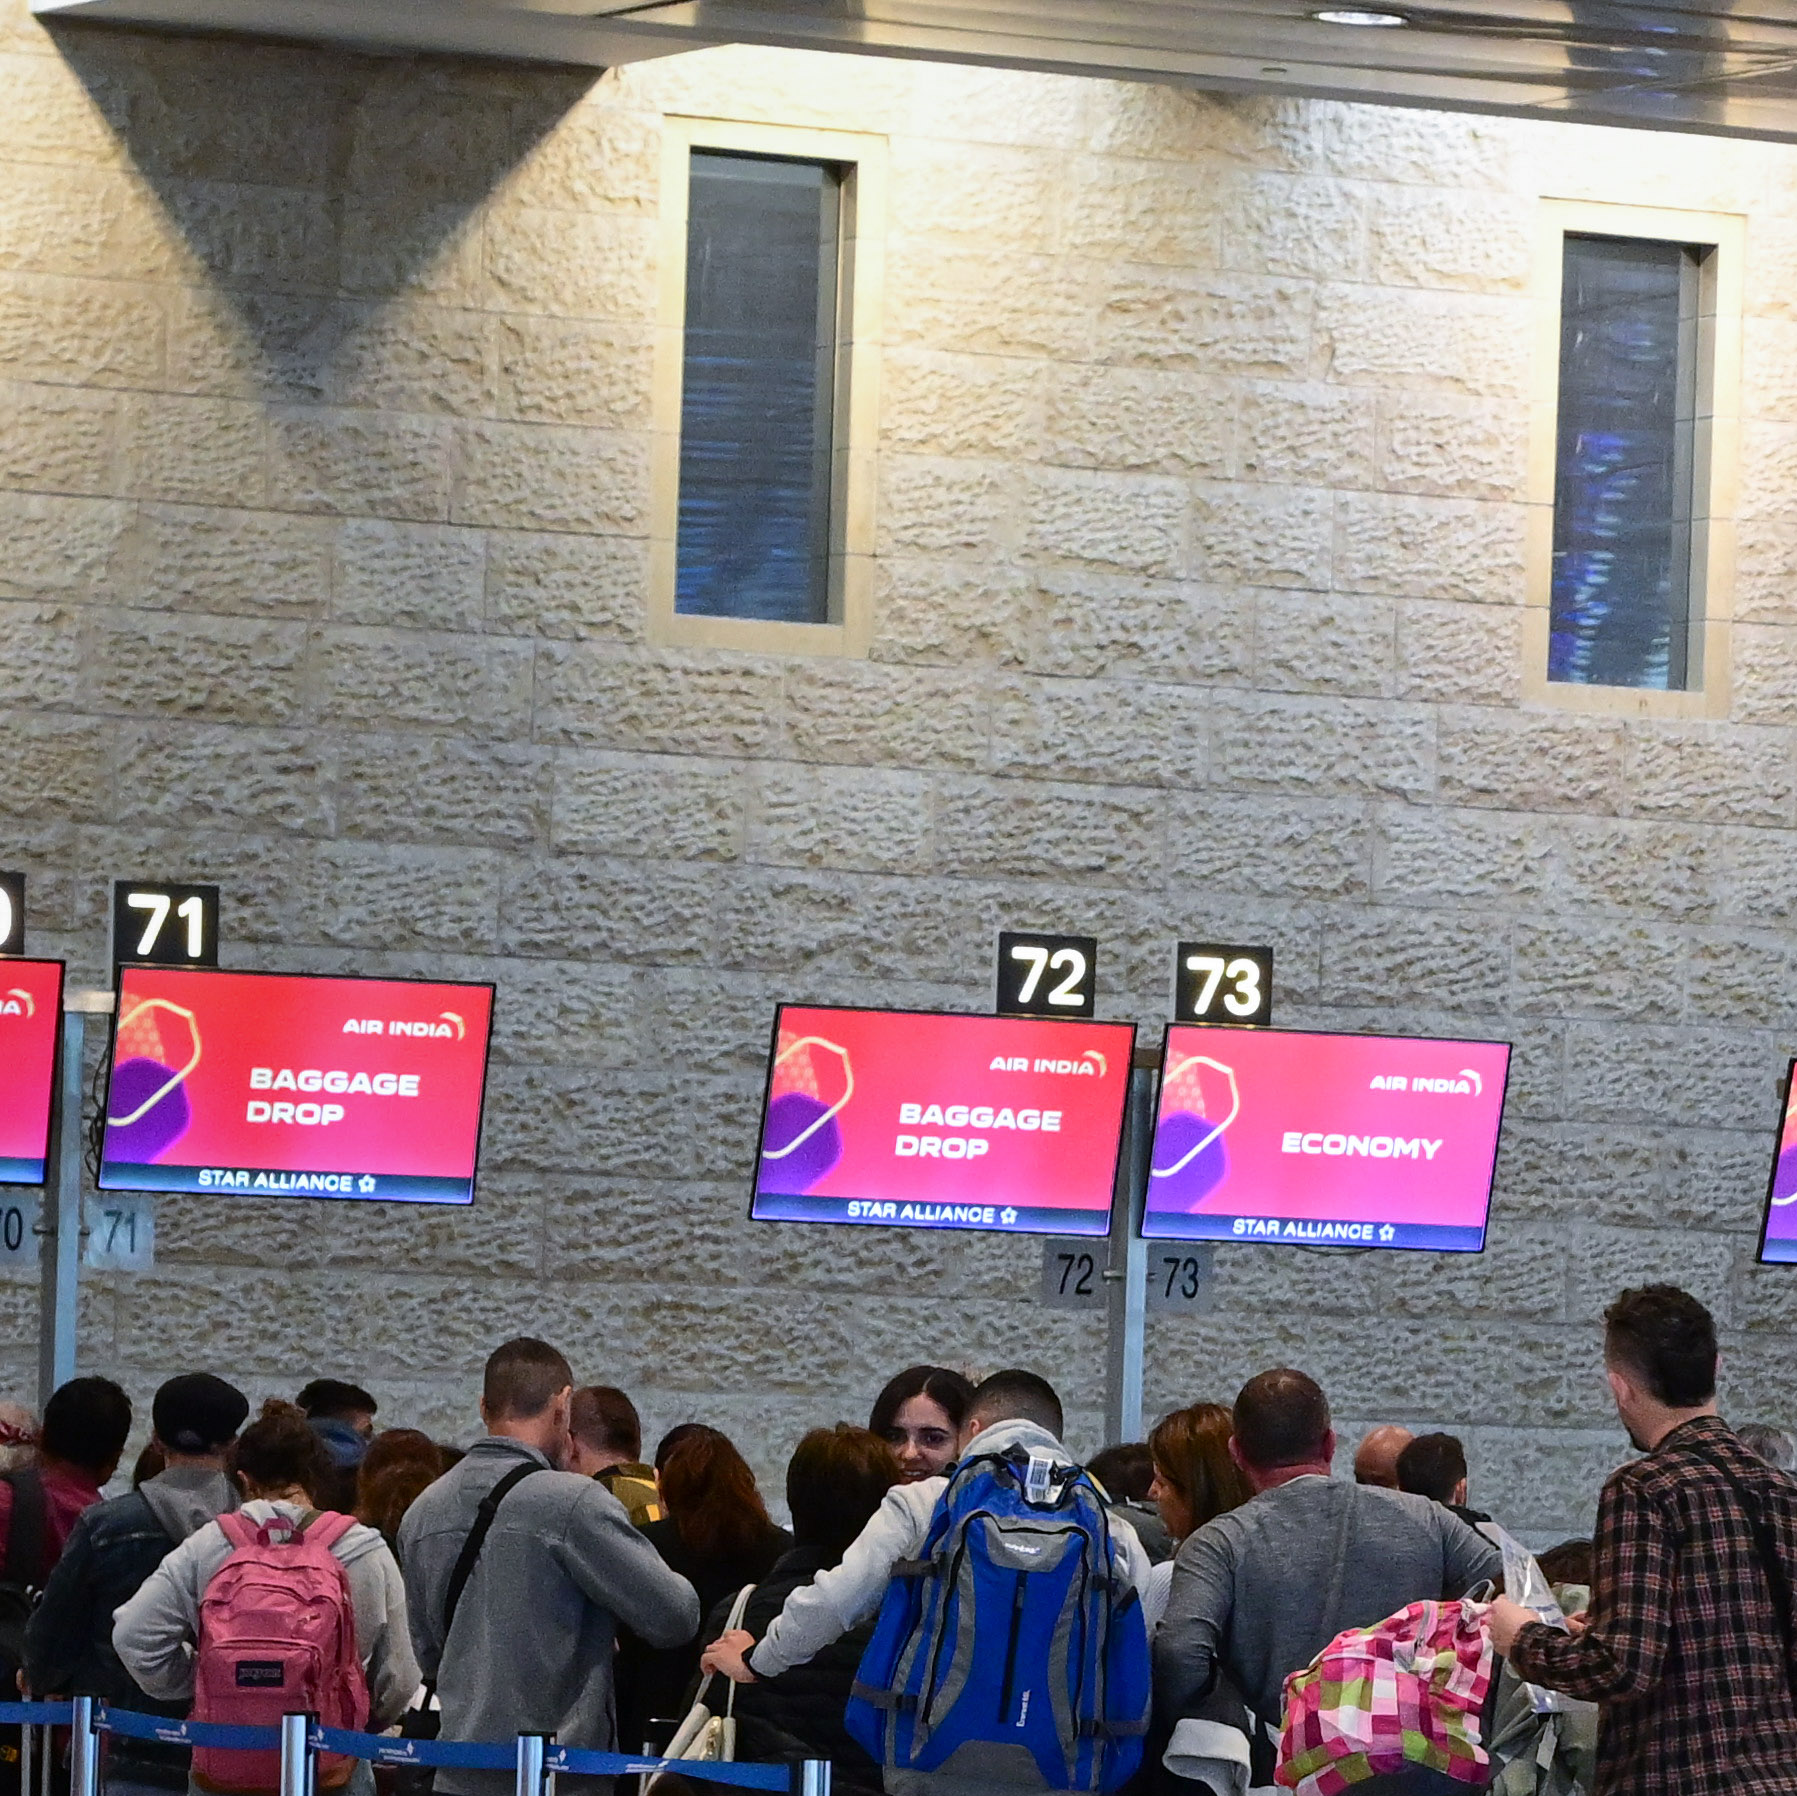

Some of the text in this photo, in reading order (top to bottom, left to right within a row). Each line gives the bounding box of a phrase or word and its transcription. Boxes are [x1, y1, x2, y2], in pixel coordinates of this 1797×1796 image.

[127, 893, 204, 957] 71
[1011, 945, 1087, 1006] 72
[1186, 956, 1261, 1016] 73
[342, 1018, 453, 1038] AIR INDIA
[989, 1056, 1095, 1075] AIR INDIA
[249, 1066, 421, 1097] BAGGAGE
[1369, 1075, 1471, 1094] AIR INDIA
[246, 1100, 345, 1125] DROP
[899, 1103, 1063, 1131] BAGGAGE
[895, 1134, 989, 1159] DROP
[1281, 1131, 1444, 1160] ECONOMY
[197, 1170, 353, 1192] STAR ALLIANCE
[847, 1200, 994, 1224] STAR ALLIANCE
[103, 1209, 136, 1253] 71
[1232, 1218, 1374, 1240] STAR ALLIANCE
[1058, 1253, 1095, 1296] 72
[1163, 1256, 1200, 1299] 73
